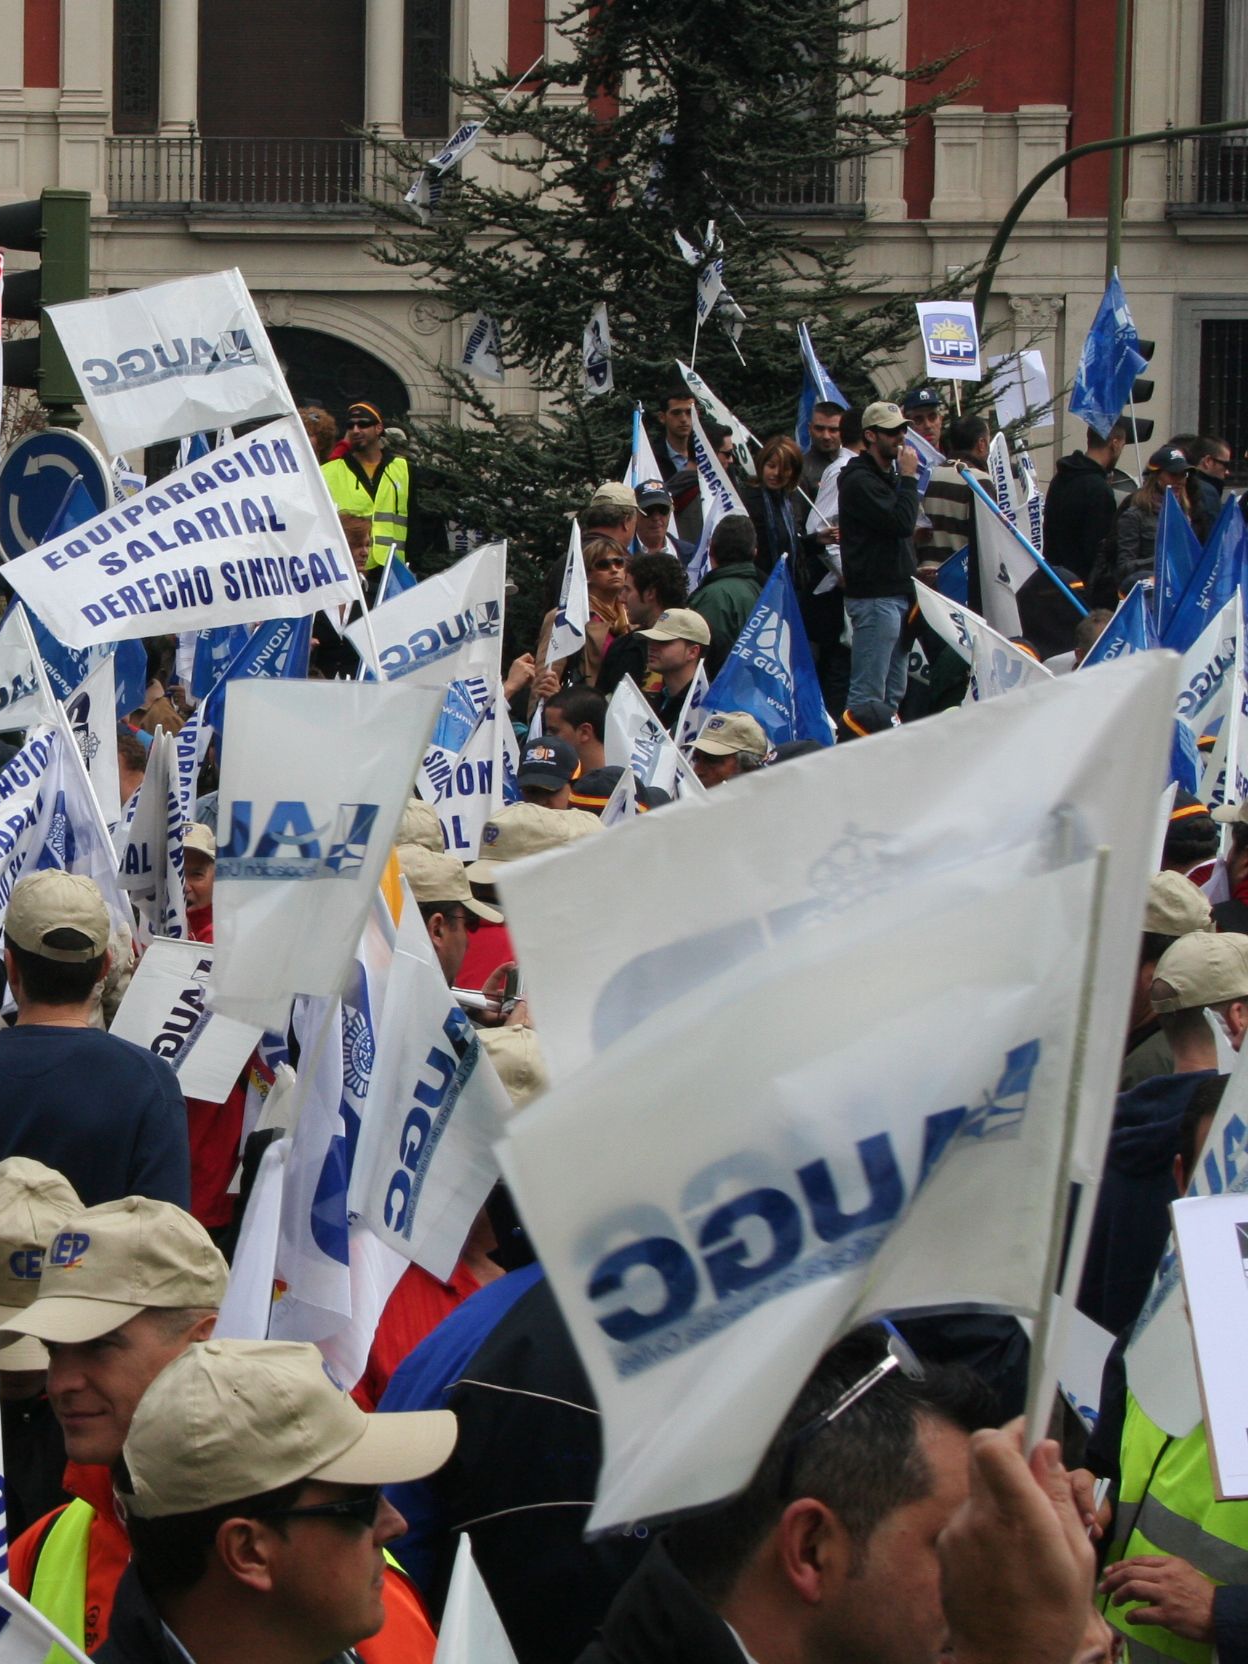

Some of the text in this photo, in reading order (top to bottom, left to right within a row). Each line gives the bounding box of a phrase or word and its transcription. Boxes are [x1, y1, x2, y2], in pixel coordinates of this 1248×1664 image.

[929, 339, 974, 358] UFP
[42, 437, 300, 572] EQUIPARACIÓN
[98, 494, 286, 576] SALARIAL
[81, 548, 349, 627] DERECHO SINDICAL
[247, 621, 292, 676] UNION
[9, 1250, 43, 1280] CE
